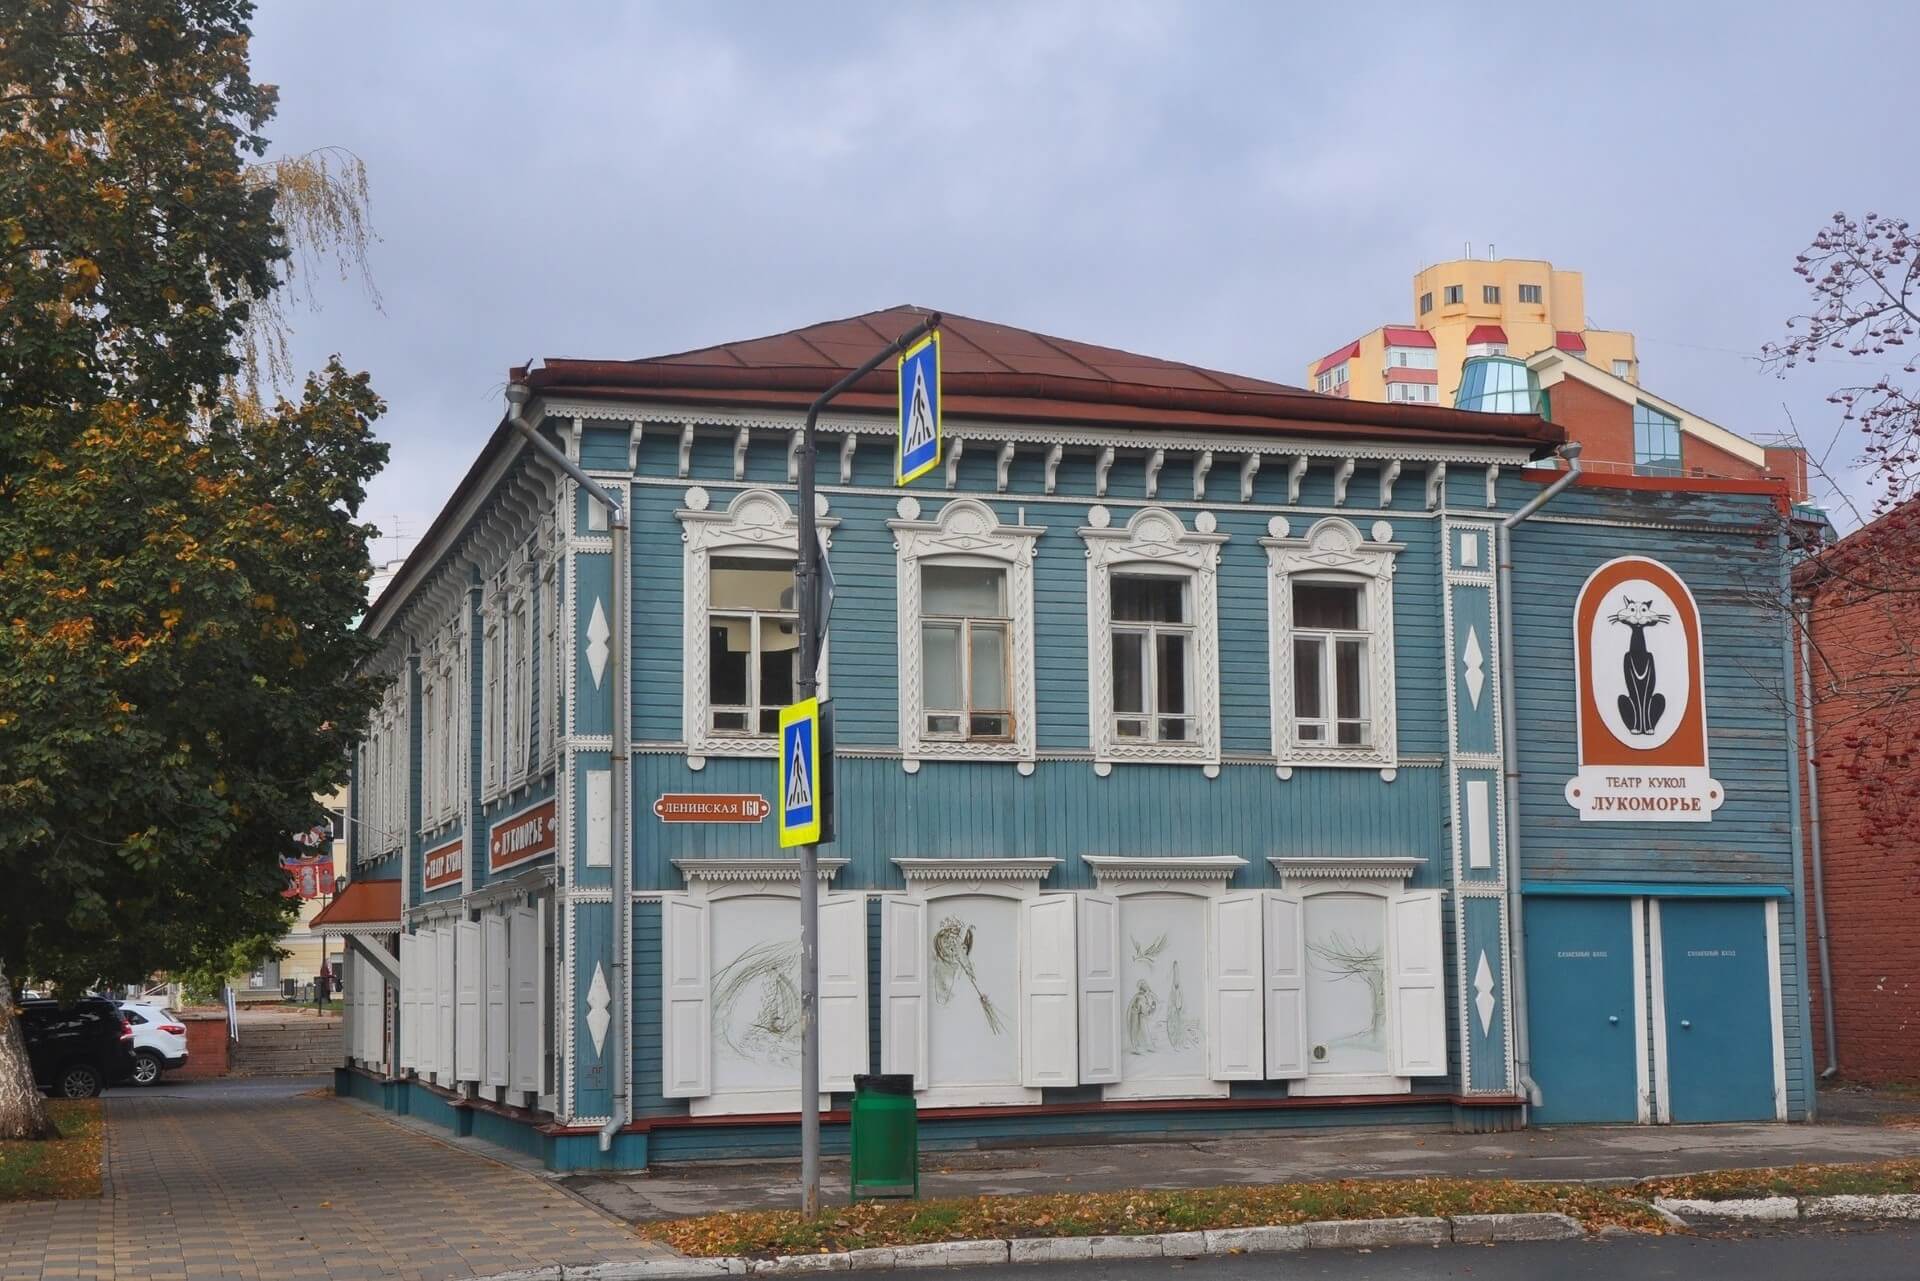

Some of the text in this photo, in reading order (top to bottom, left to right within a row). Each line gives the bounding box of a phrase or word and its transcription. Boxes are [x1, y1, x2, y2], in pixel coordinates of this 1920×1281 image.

[1606, 776, 1686, 788] ТЕАТР КУКОЛ
[665, 800, 759, 816] ЛЕНИНСКАЯ 160
[1591, 796, 1702, 811] ЛУКОМОРЬЕ
